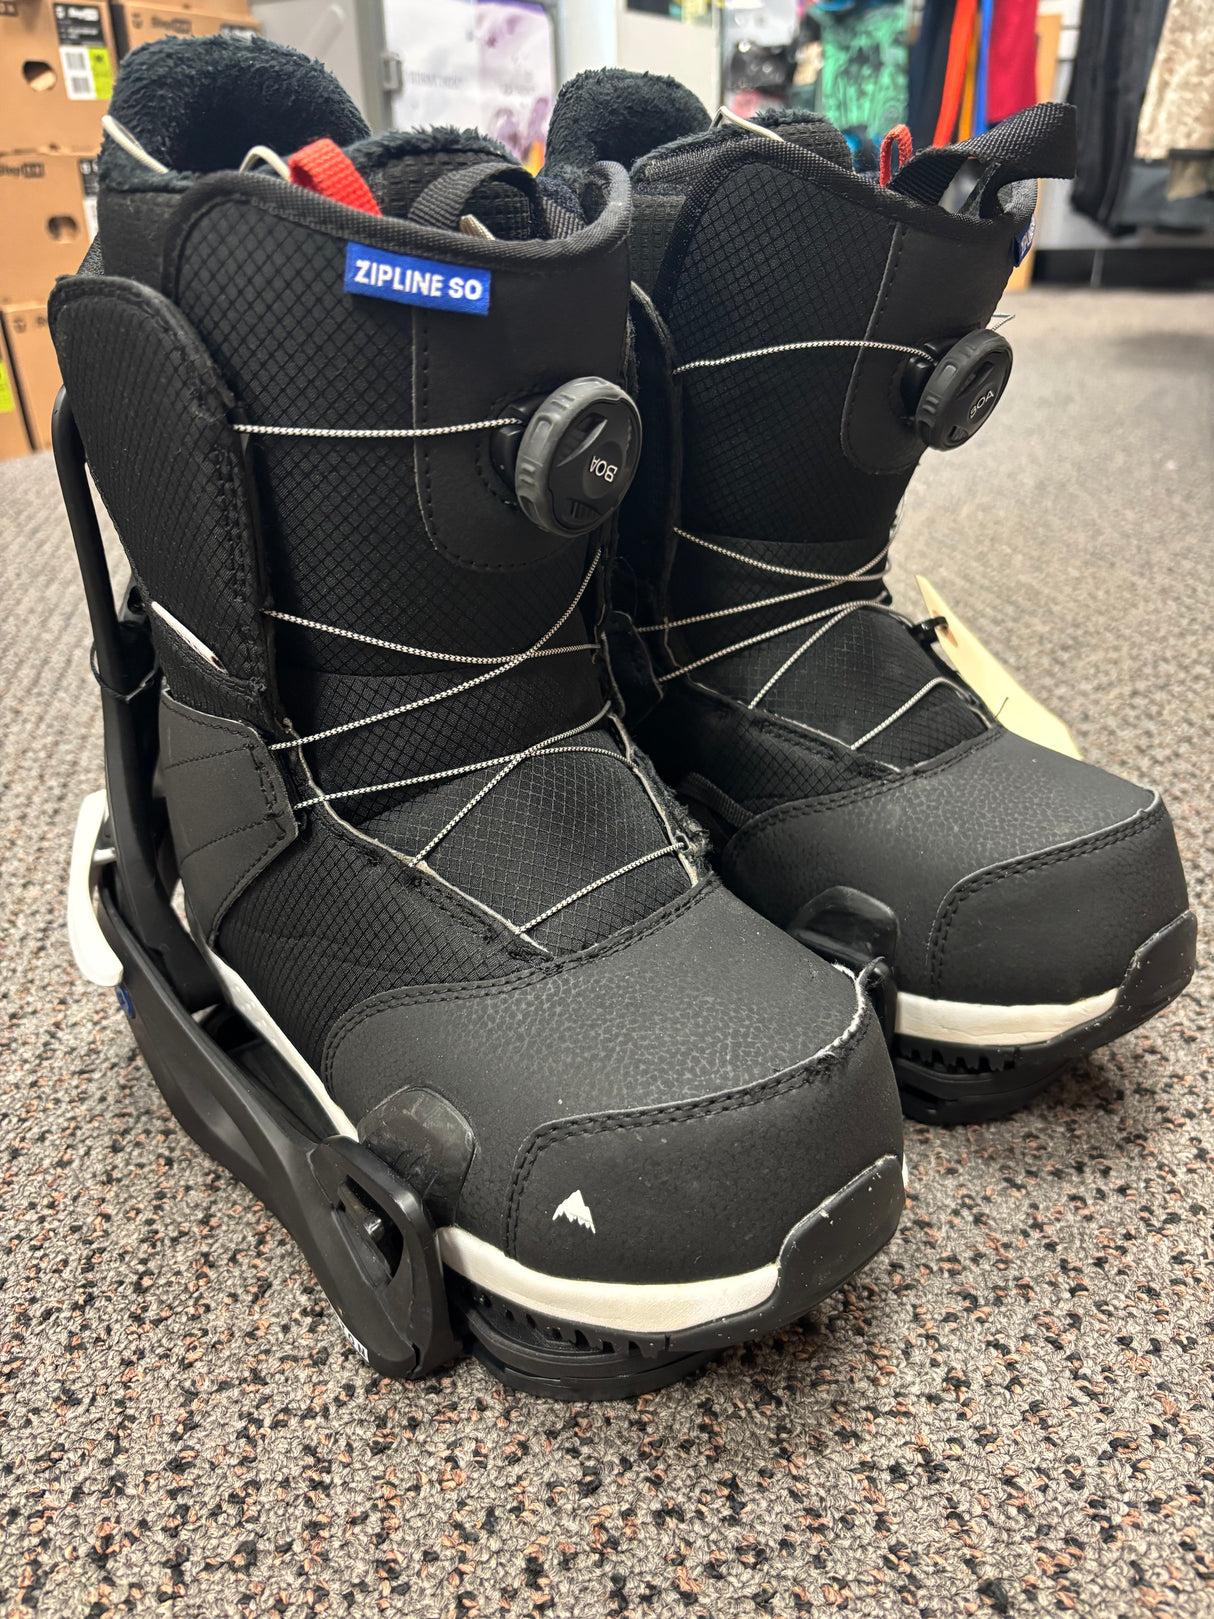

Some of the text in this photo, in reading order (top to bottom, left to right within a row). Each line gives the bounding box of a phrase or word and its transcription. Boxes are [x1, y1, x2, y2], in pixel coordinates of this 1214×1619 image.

[354, 259, 482, 300] ZIPLINE SO
[589, 455, 618, 482] BOA
